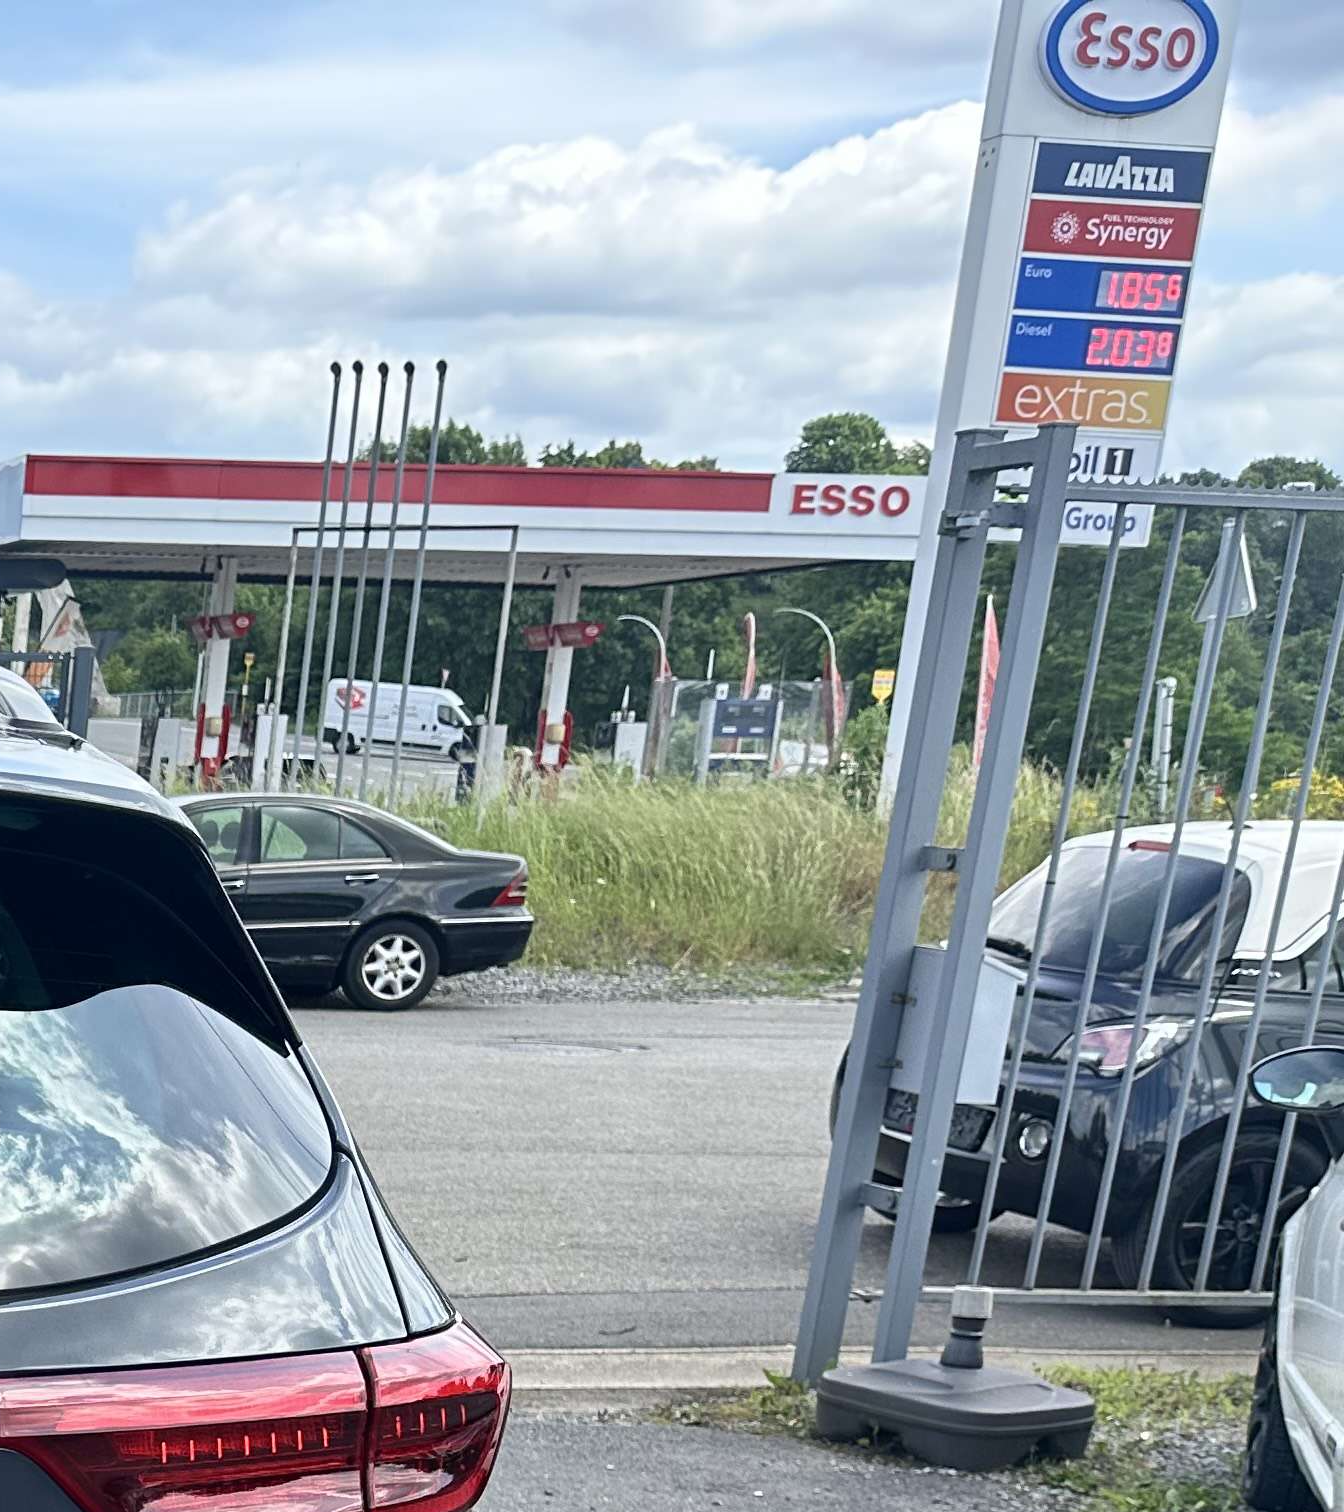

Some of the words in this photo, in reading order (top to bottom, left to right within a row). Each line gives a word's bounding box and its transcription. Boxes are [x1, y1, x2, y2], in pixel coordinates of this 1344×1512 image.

[1064, 155, 1175, 193] LAVAZZA
[1085, 218, 1172, 250] Synergy
[1024, 264, 1053, 279] Euro
[1015, 322, 1053, 337] Diesel
[791, 484, 911, 517] ESSO
